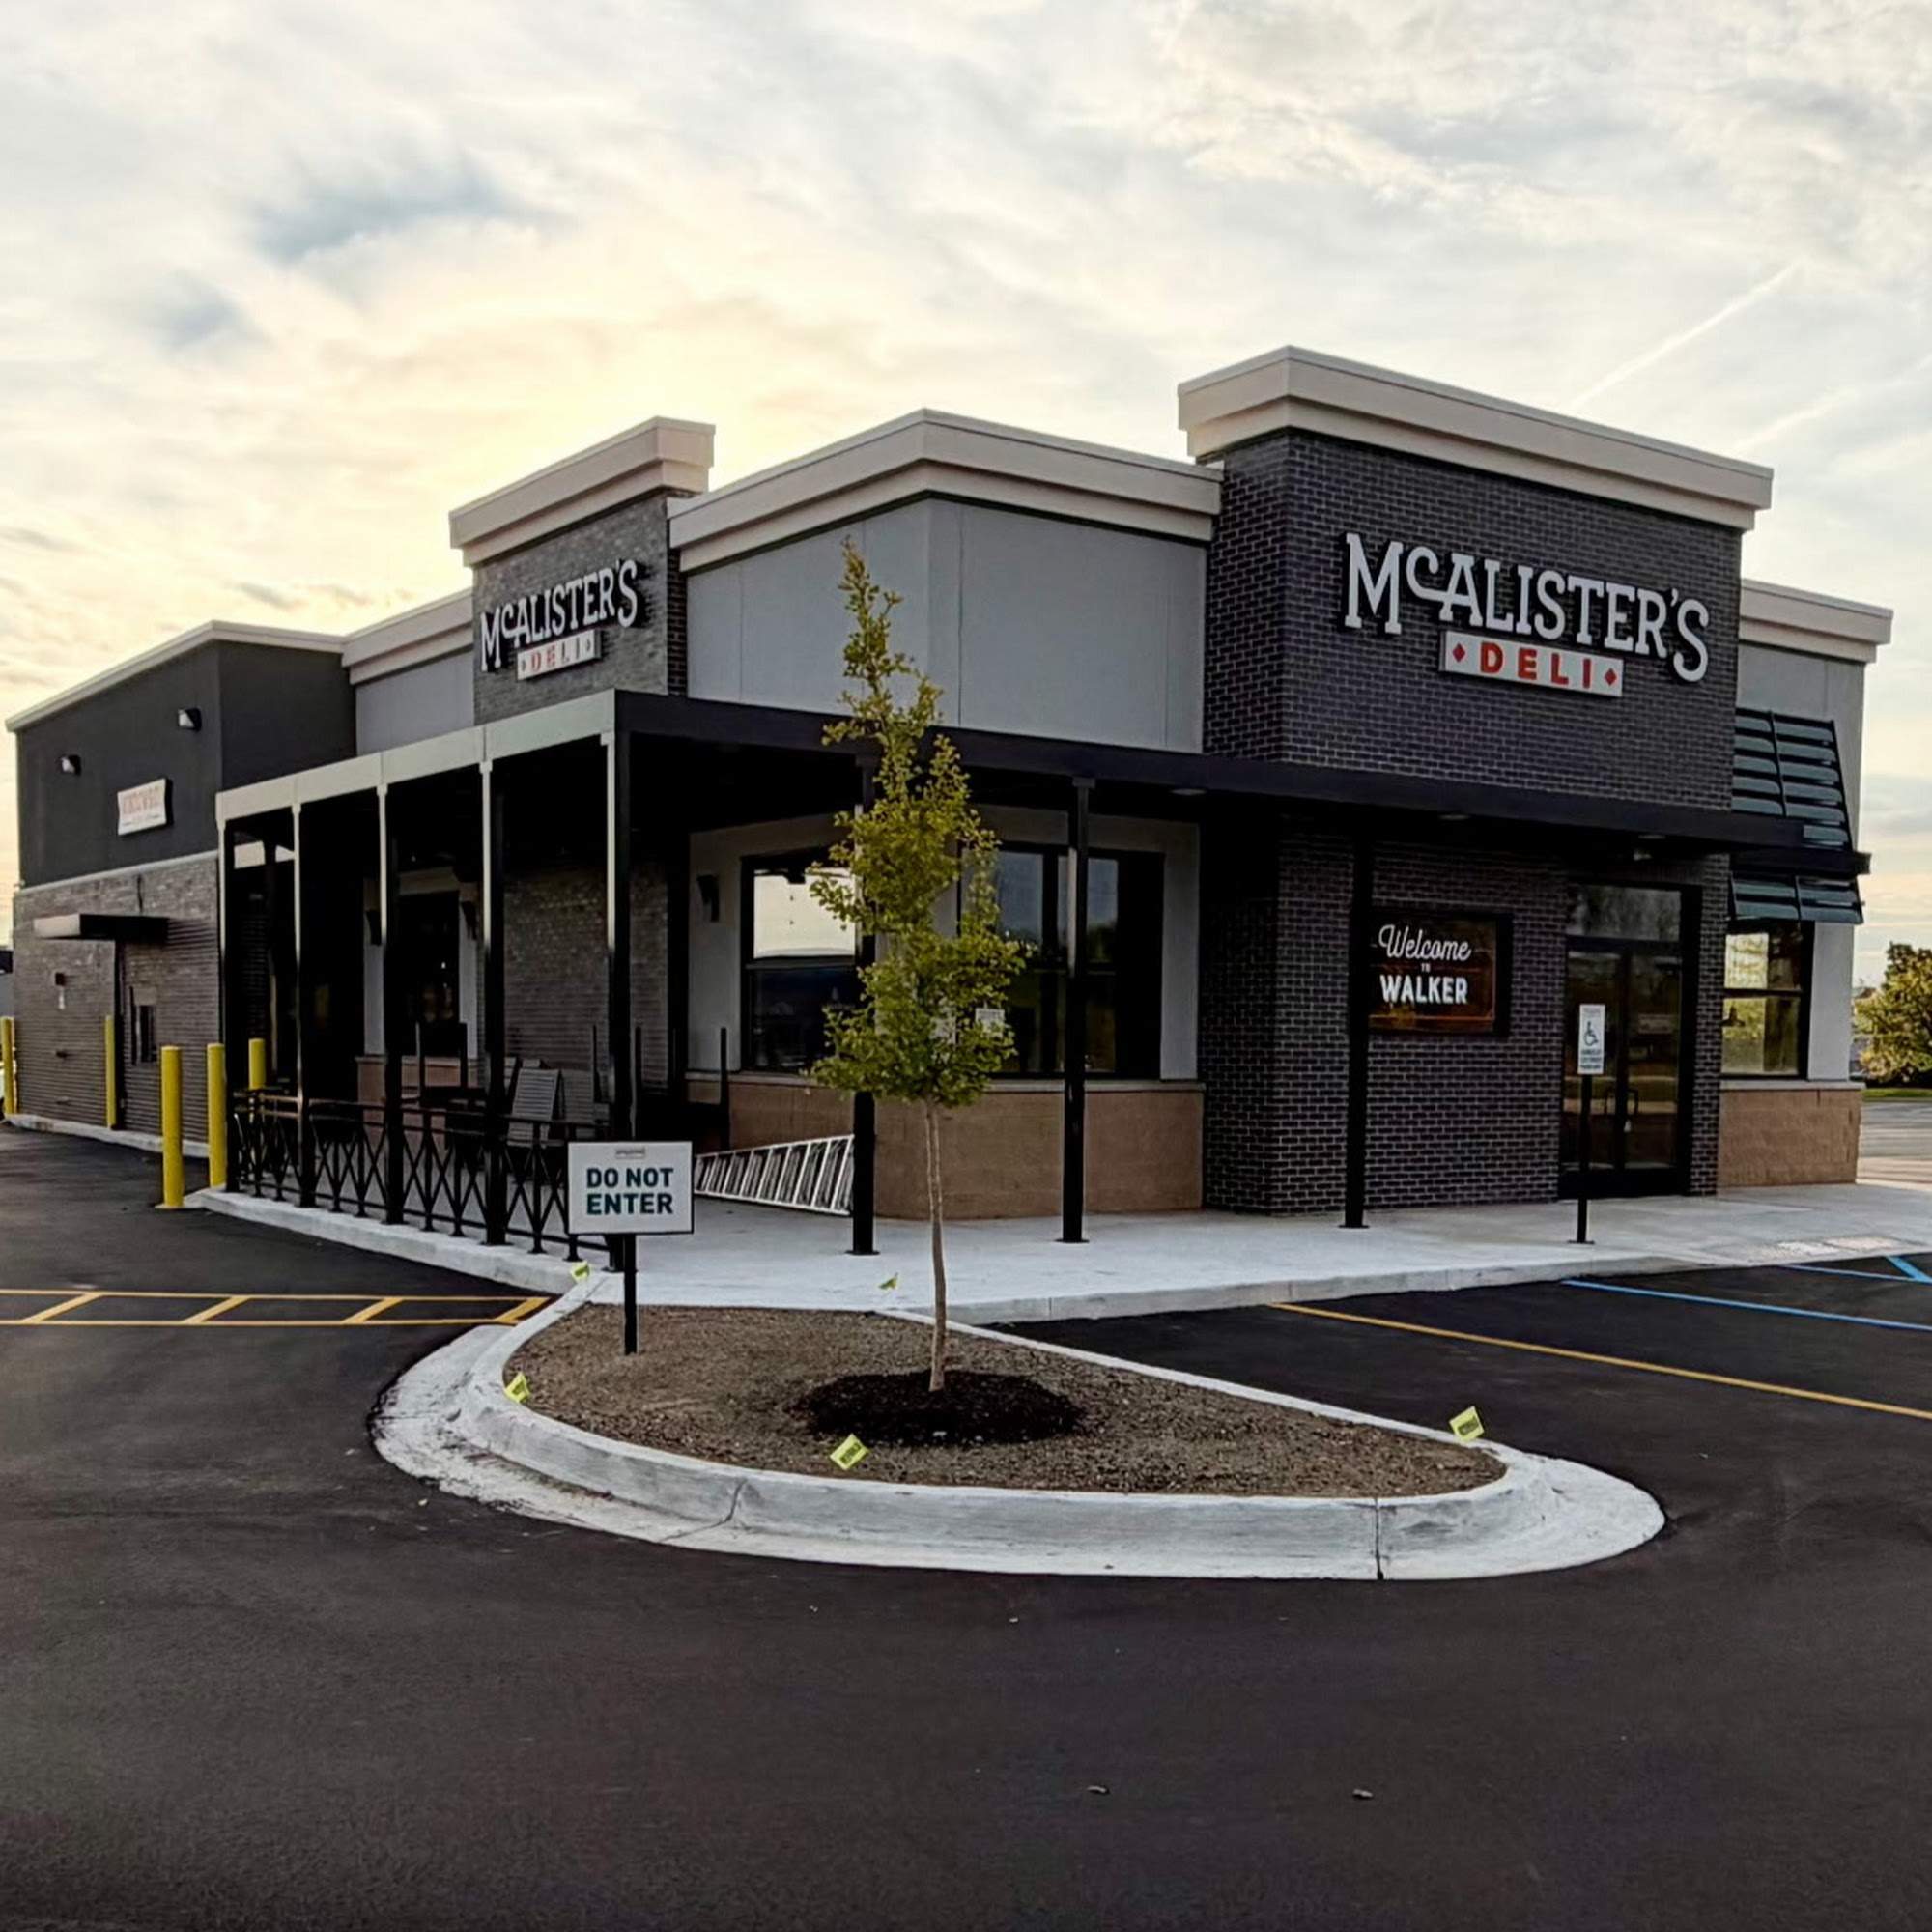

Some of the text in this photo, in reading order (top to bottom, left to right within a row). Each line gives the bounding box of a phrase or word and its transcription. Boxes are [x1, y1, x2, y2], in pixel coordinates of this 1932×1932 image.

[532, 638, 580, 671] DELI
[1480, 641, 1592, 689] DELI
[1378, 924, 1472, 961] Welcome
[1379, 974, 1468, 1004] WALKER
[586, 1167, 674, 1188] DO NOT
[586, 1192, 673, 1215] ENTER
